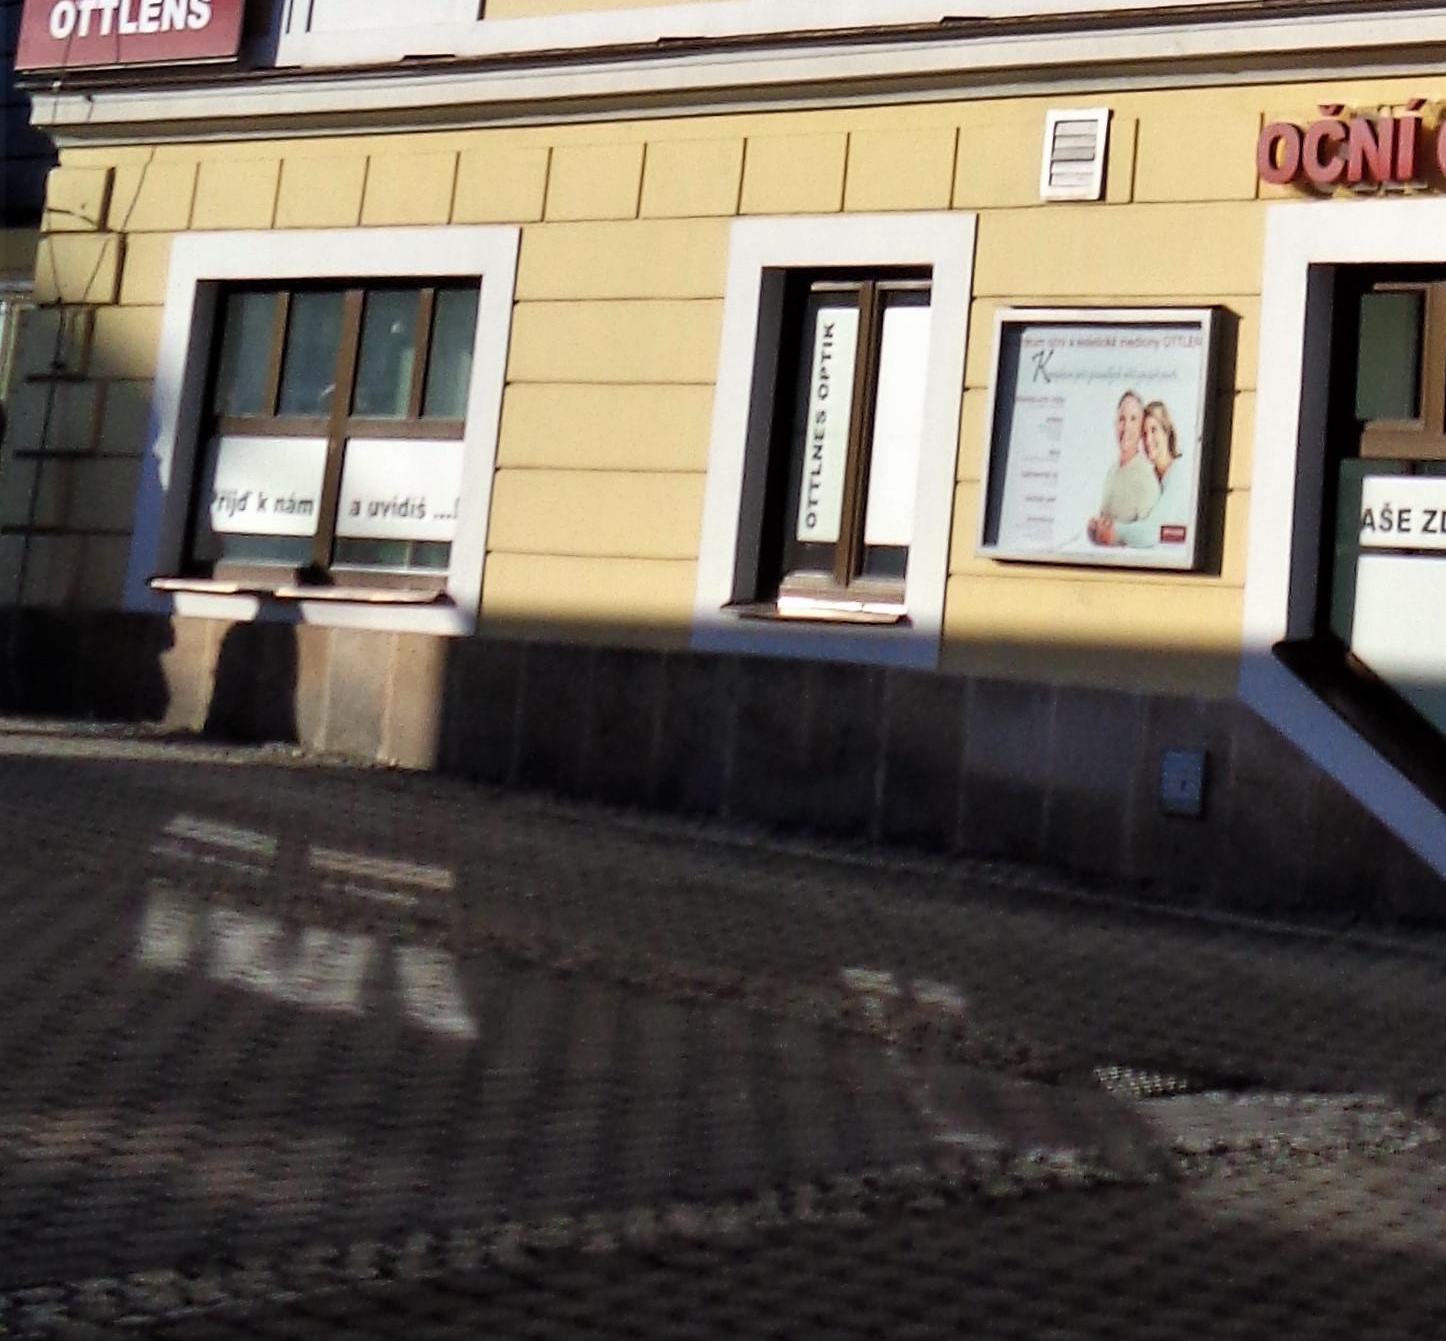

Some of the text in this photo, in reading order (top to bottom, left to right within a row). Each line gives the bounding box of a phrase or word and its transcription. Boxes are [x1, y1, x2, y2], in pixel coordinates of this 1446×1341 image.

[1256, 98, 1426, 186] OČNÍ
[817, 322, 835, 401] OPTIK
[256, 491, 269, 513] k
[273, 491, 314, 516] nám
[348, 500, 361, 517] a
[1361, 503, 1412, 533] AŠE
